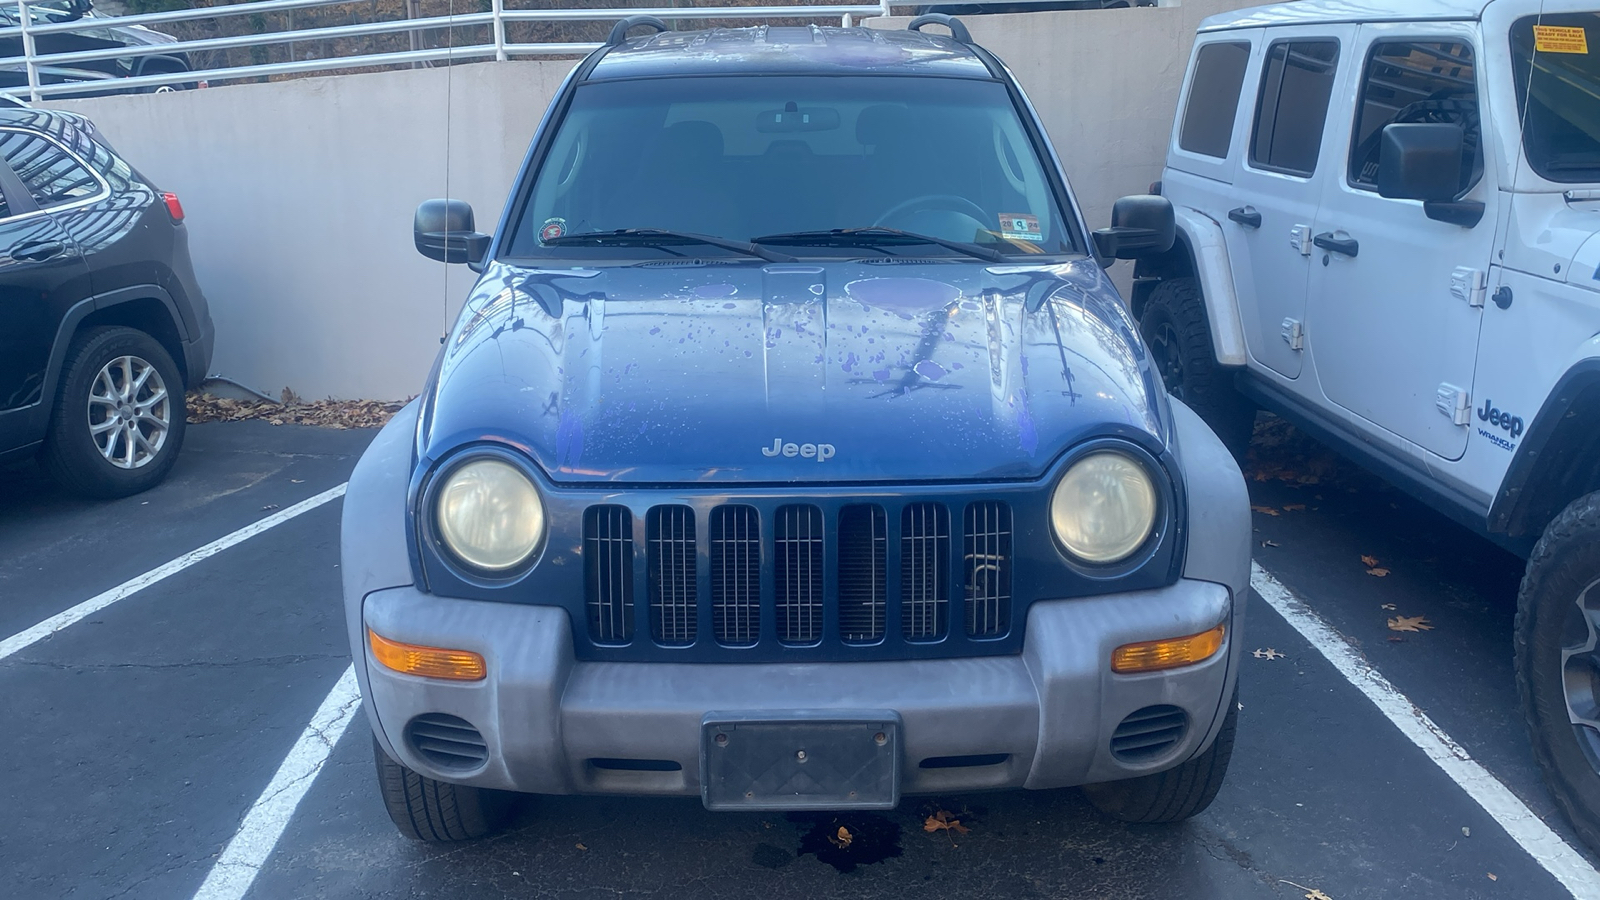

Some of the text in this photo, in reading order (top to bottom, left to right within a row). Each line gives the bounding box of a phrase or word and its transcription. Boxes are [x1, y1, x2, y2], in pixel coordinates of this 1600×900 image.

[1016, 220, 1024, 230] 9
[1477, 399, 1524, 439] Jeep
[761, 438, 836, 462] Jeep
